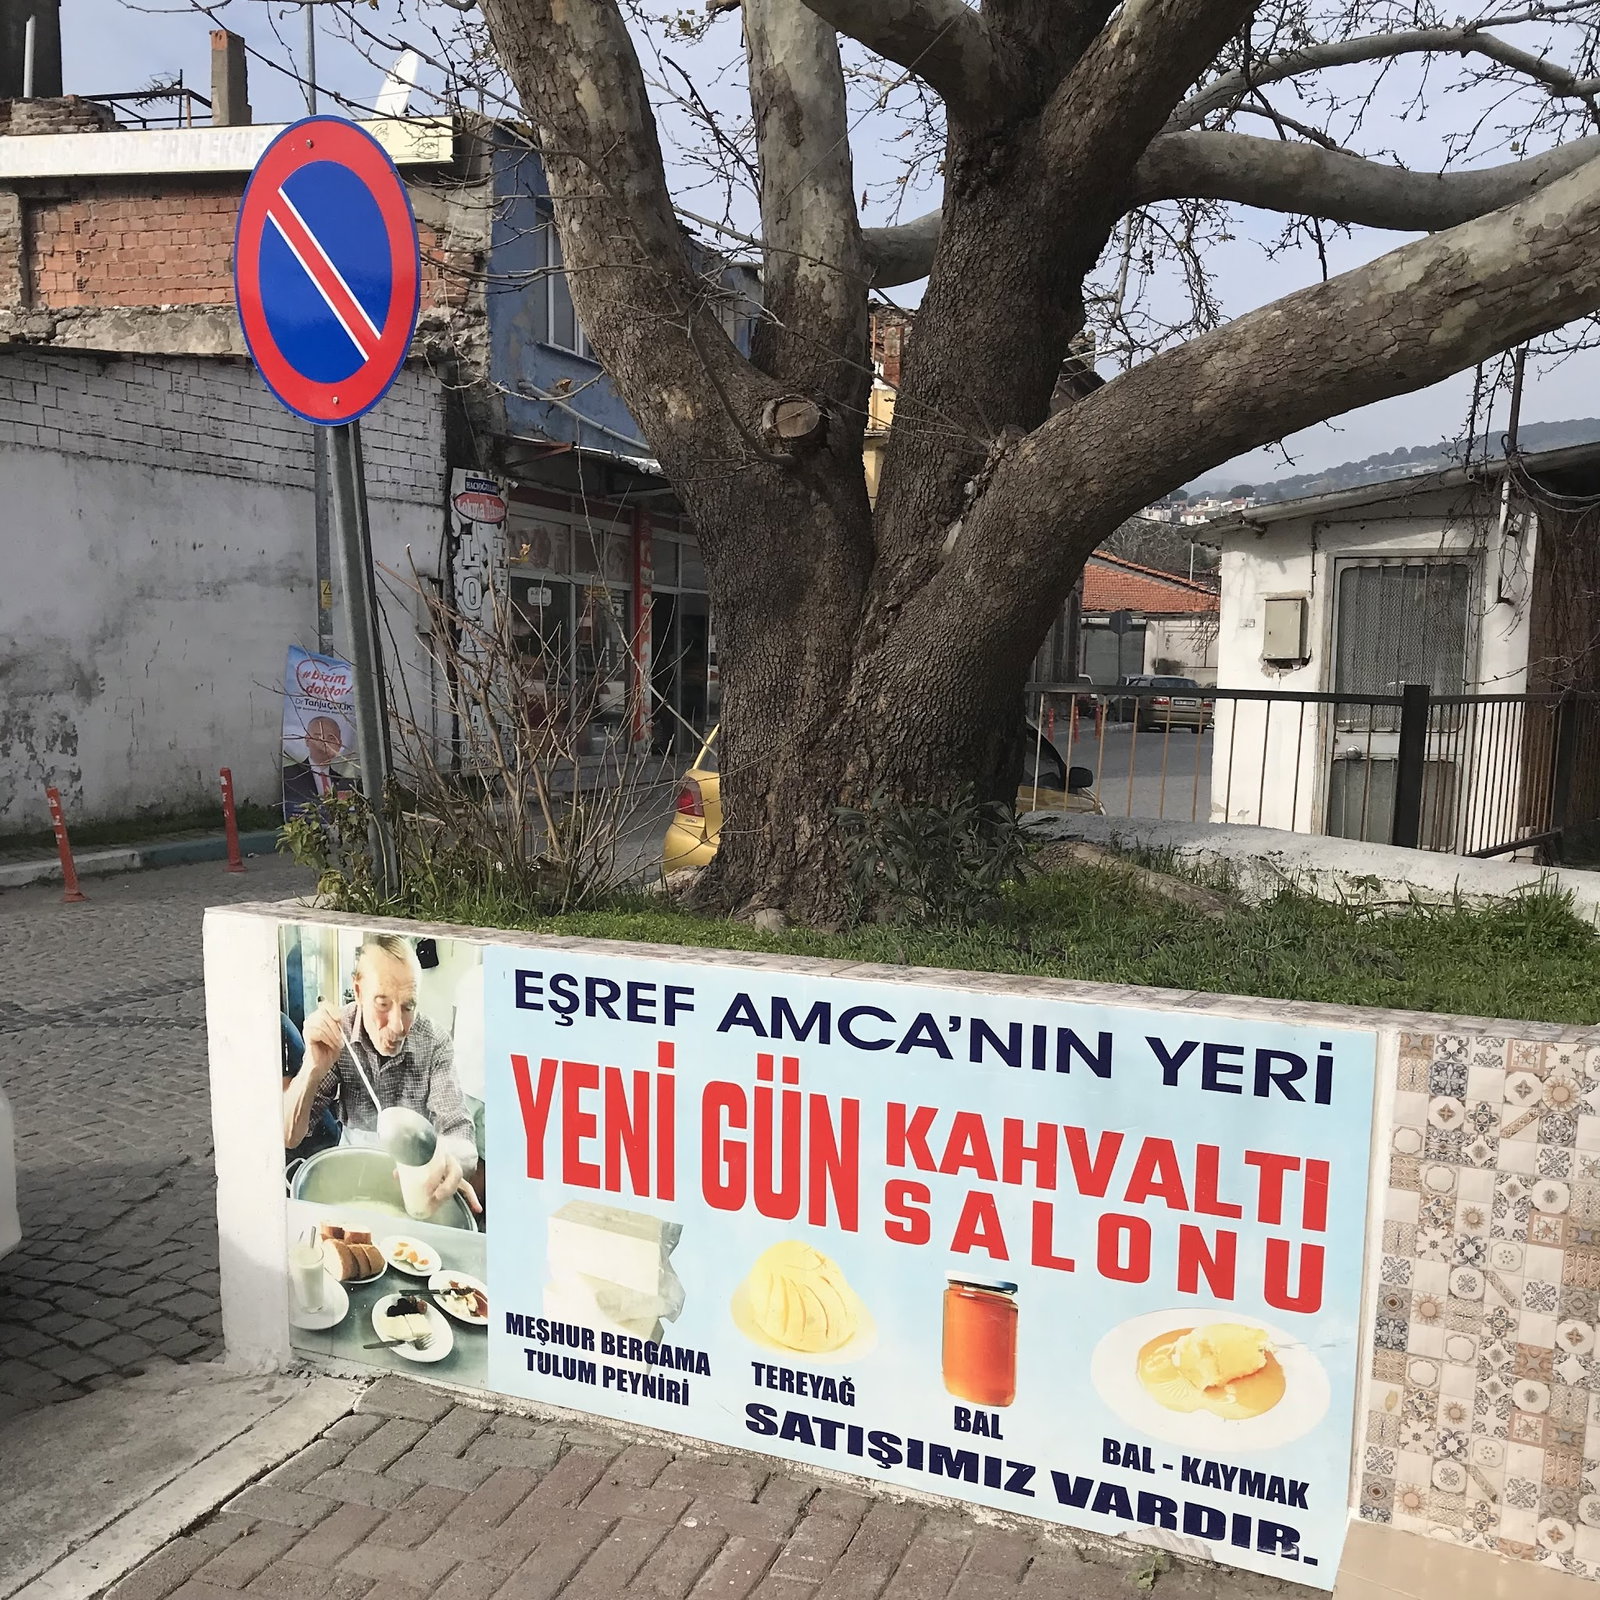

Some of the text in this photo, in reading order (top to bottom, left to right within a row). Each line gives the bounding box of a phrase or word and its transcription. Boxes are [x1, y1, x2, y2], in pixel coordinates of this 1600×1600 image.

[302, 670, 346, 685] #bizim
[514, 969, 1334, 1105] EŞREF AMCA'NIN YERİ
[510, 1040, 1330, 1233] YENİ GÜN KAHVALTI
[884, 1178, 1325, 1314] SALONU
[505, 1311, 711, 1376] MEŞHUR BERGAMA
[523, 1348, 689, 1406] TULUM PEYNİRİ
[751, 1361, 856, 1407] TEREYAĞ
[953, 1405, 1004, 1440] BAL
[745, 1402, 1319, 1567] SATIŞIMIZ VARDIR.
[1102, 1437, 1155, 1474] BAL
[1181, 1455, 1310, 1510] KAYMAK
